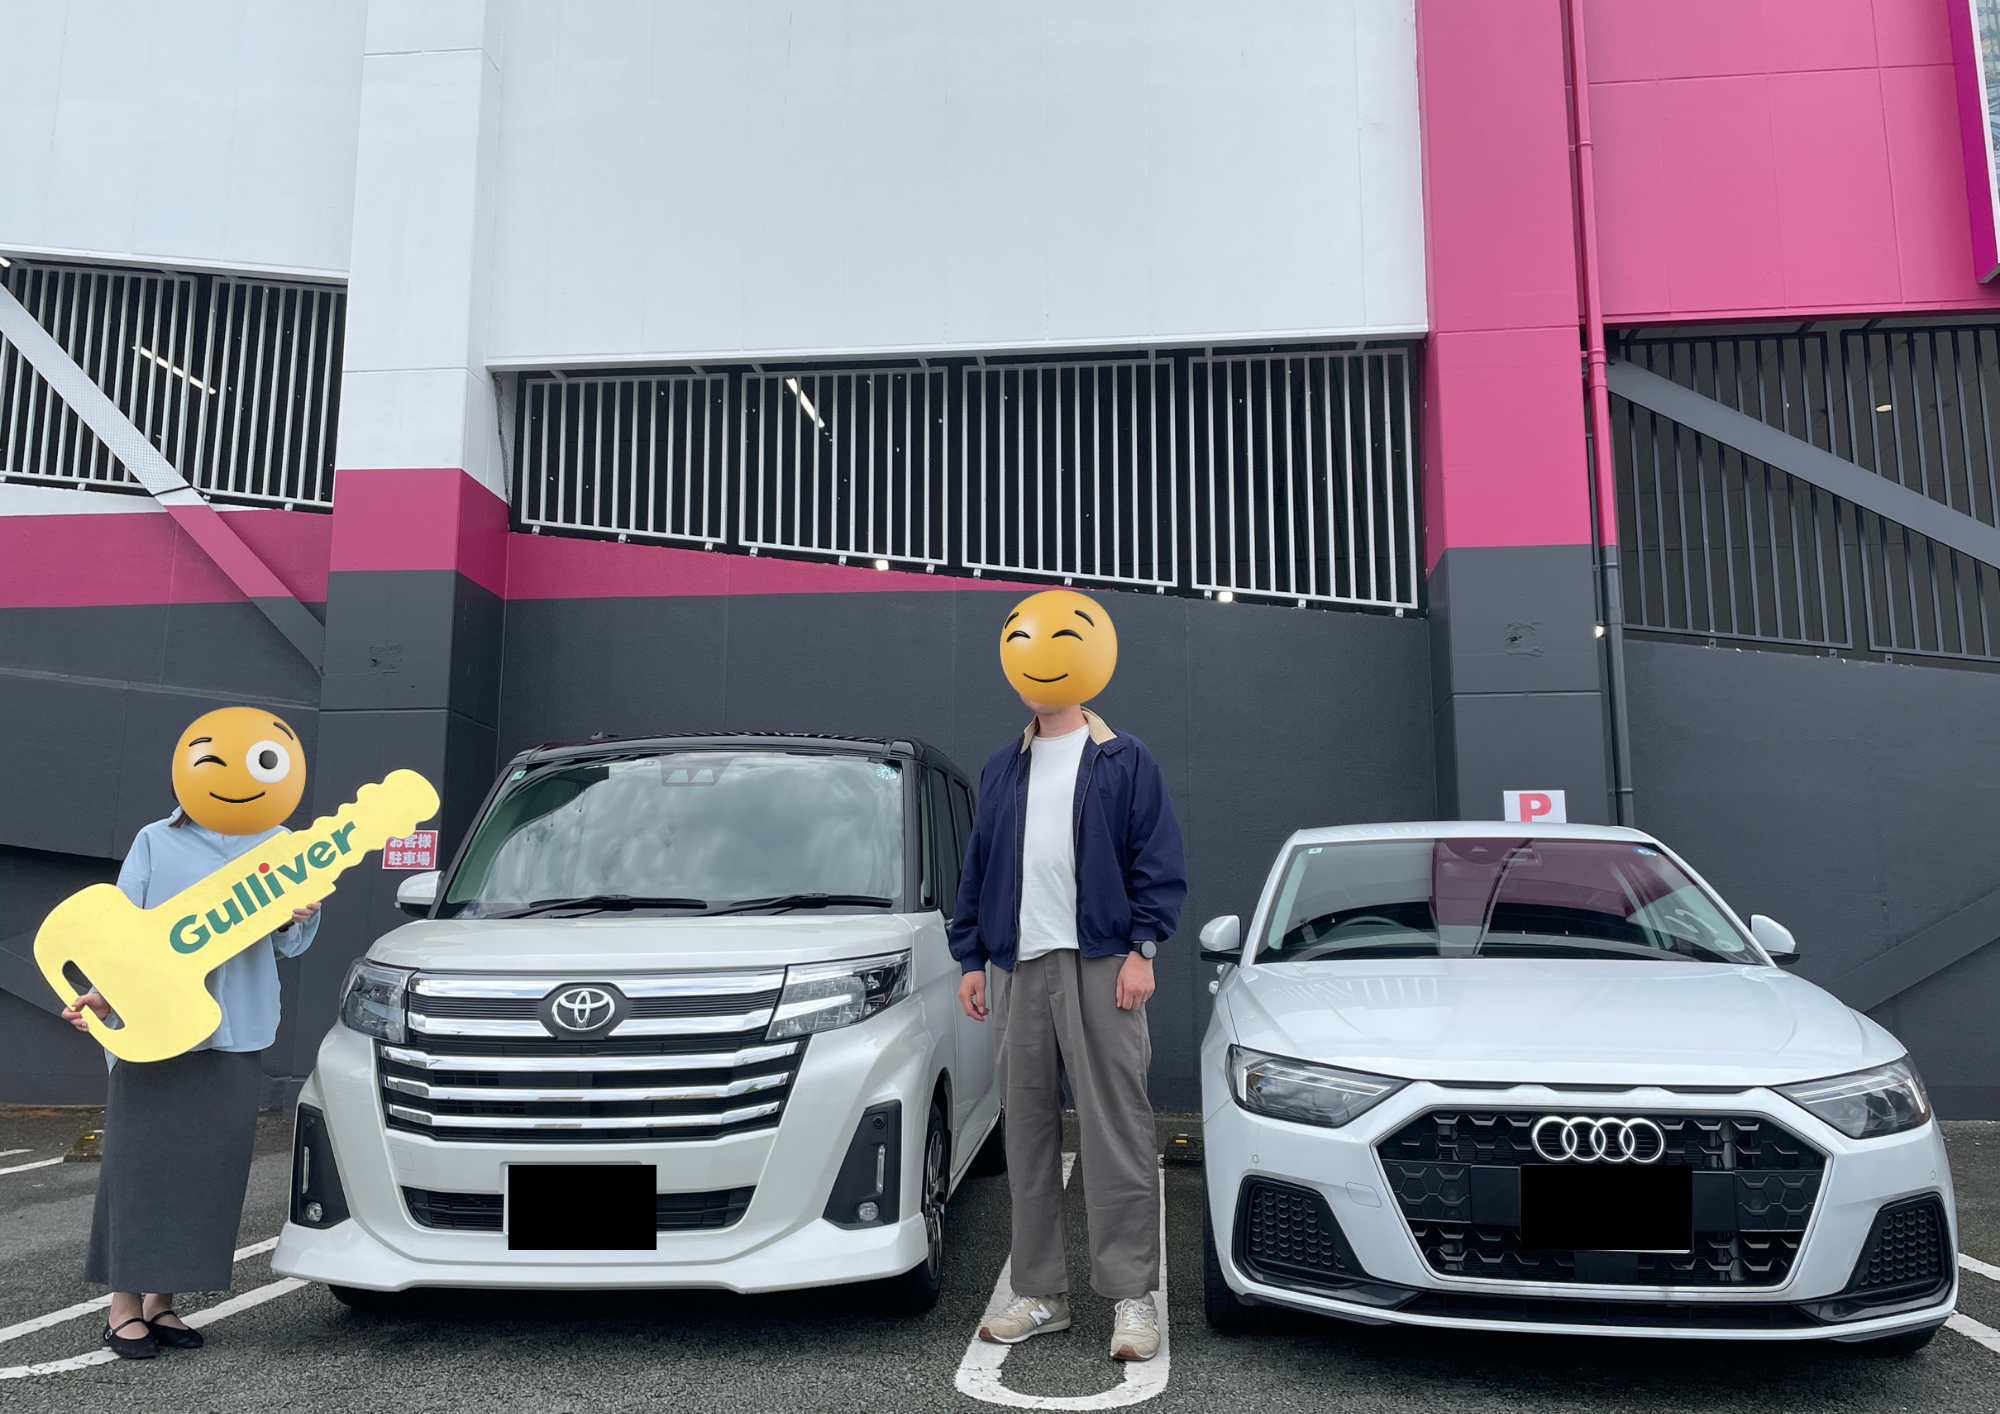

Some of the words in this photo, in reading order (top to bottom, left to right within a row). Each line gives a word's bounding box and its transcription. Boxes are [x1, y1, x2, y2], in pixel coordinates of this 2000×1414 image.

[1519, 793, 1552, 822] P
[389, 834, 432, 848] お客様
[388, 851, 431, 866] 駐車場
[169, 820, 356, 954] Gulliver
[1029, 1303, 1052, 1326] N
